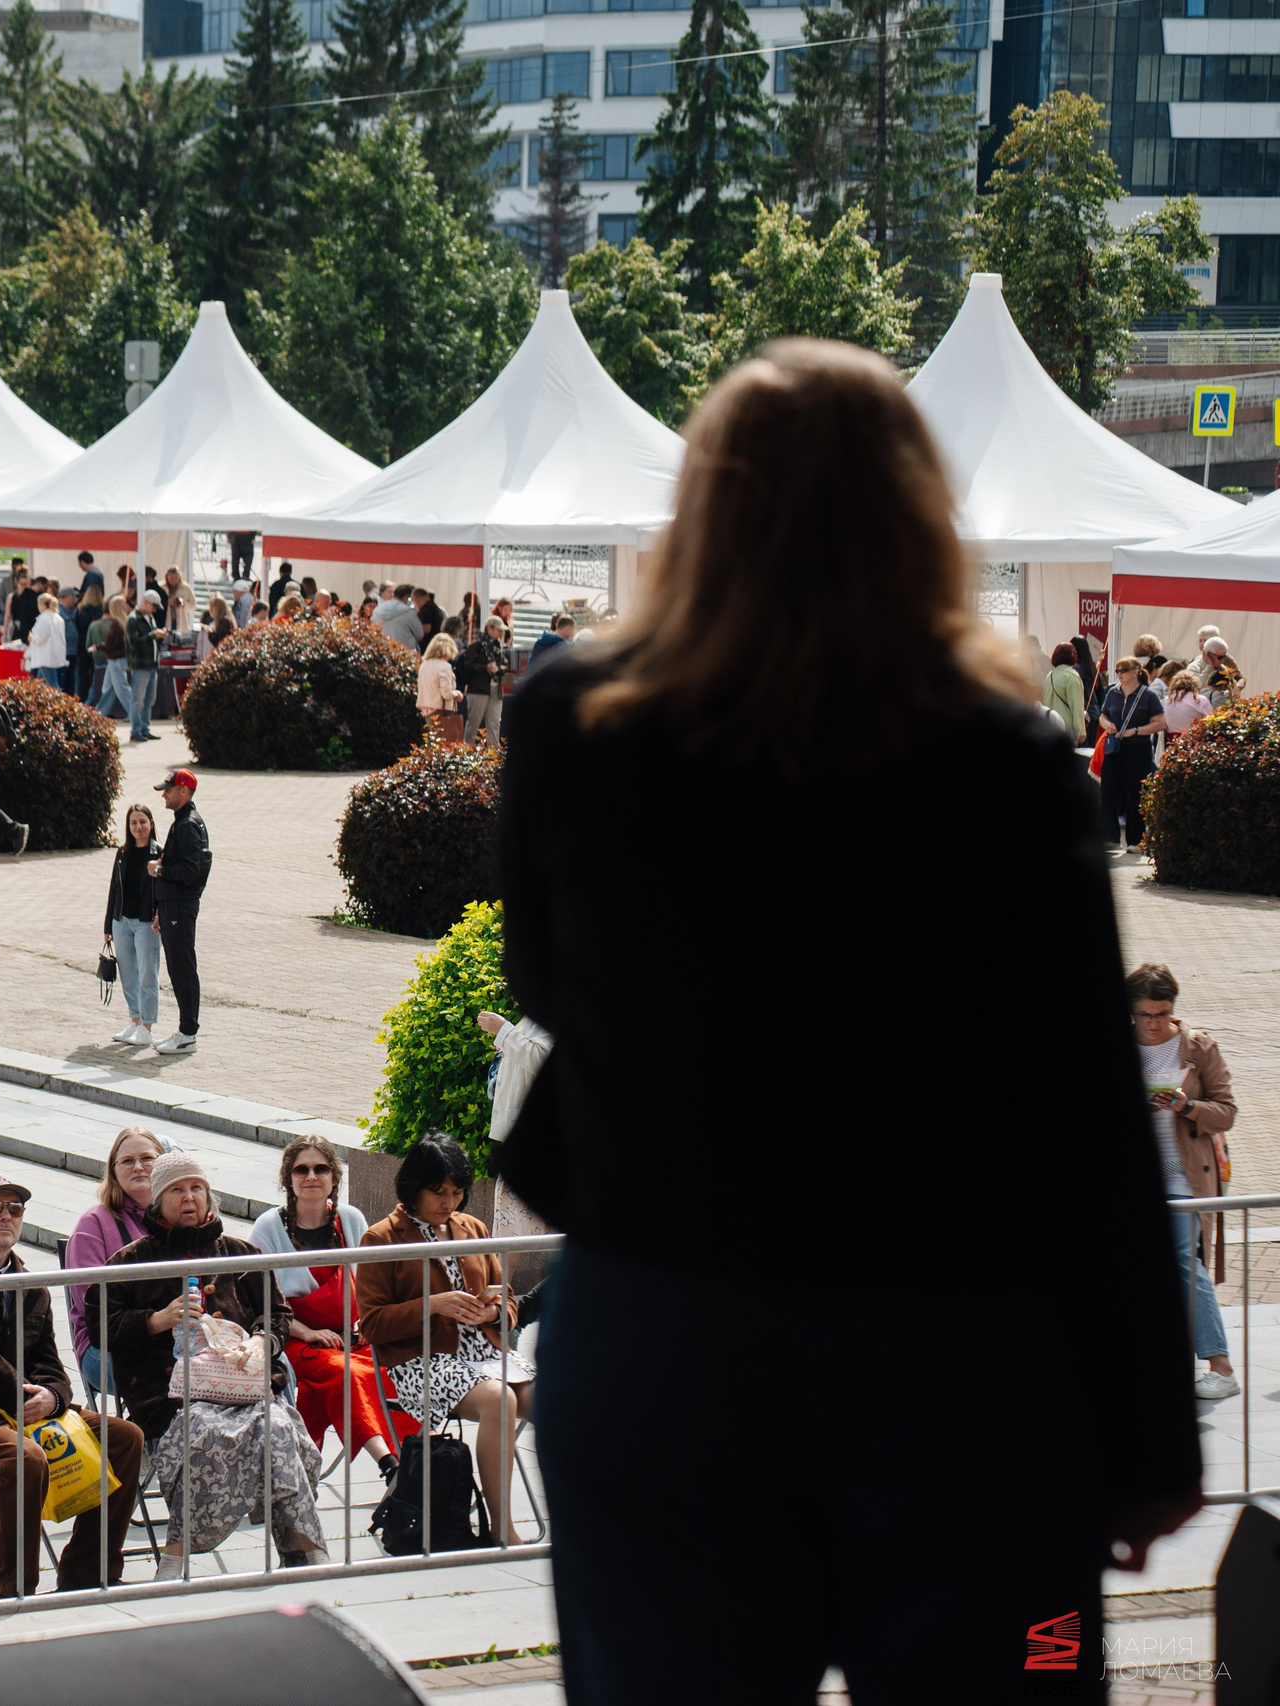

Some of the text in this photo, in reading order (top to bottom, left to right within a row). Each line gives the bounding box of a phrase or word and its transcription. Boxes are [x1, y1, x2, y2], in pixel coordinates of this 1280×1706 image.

[1081, 599, 1107, 613] ГОРЫ
[1081, 613, 1106, 627] КНИГ
[49, 1459, 82, 1476] АНСПОРТНАЯ
